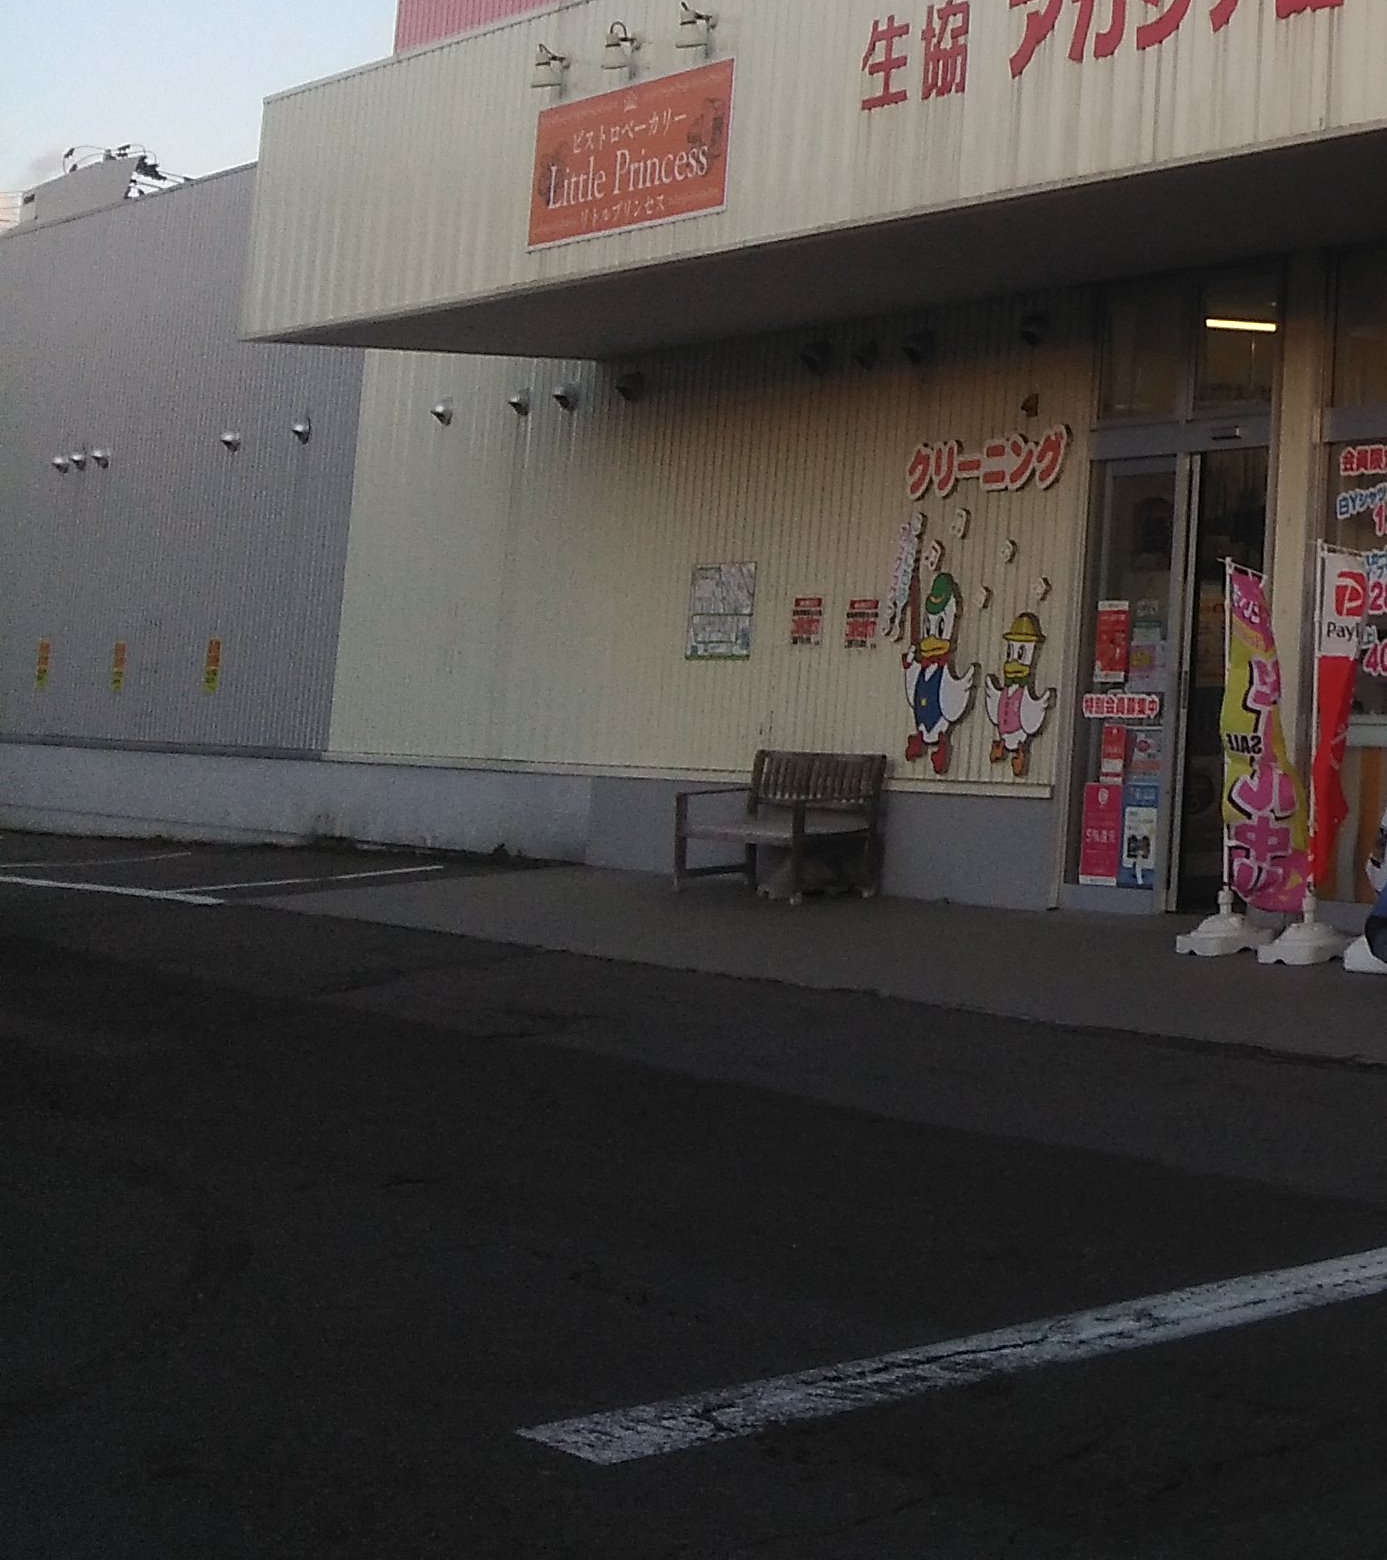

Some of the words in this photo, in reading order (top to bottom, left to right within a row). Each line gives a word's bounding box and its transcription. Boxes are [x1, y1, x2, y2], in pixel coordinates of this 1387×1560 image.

[548, 156, 607, 210] Little
[613, 144, 710, 195] Princess
[907, 425, 1071, 499] クリーニング
